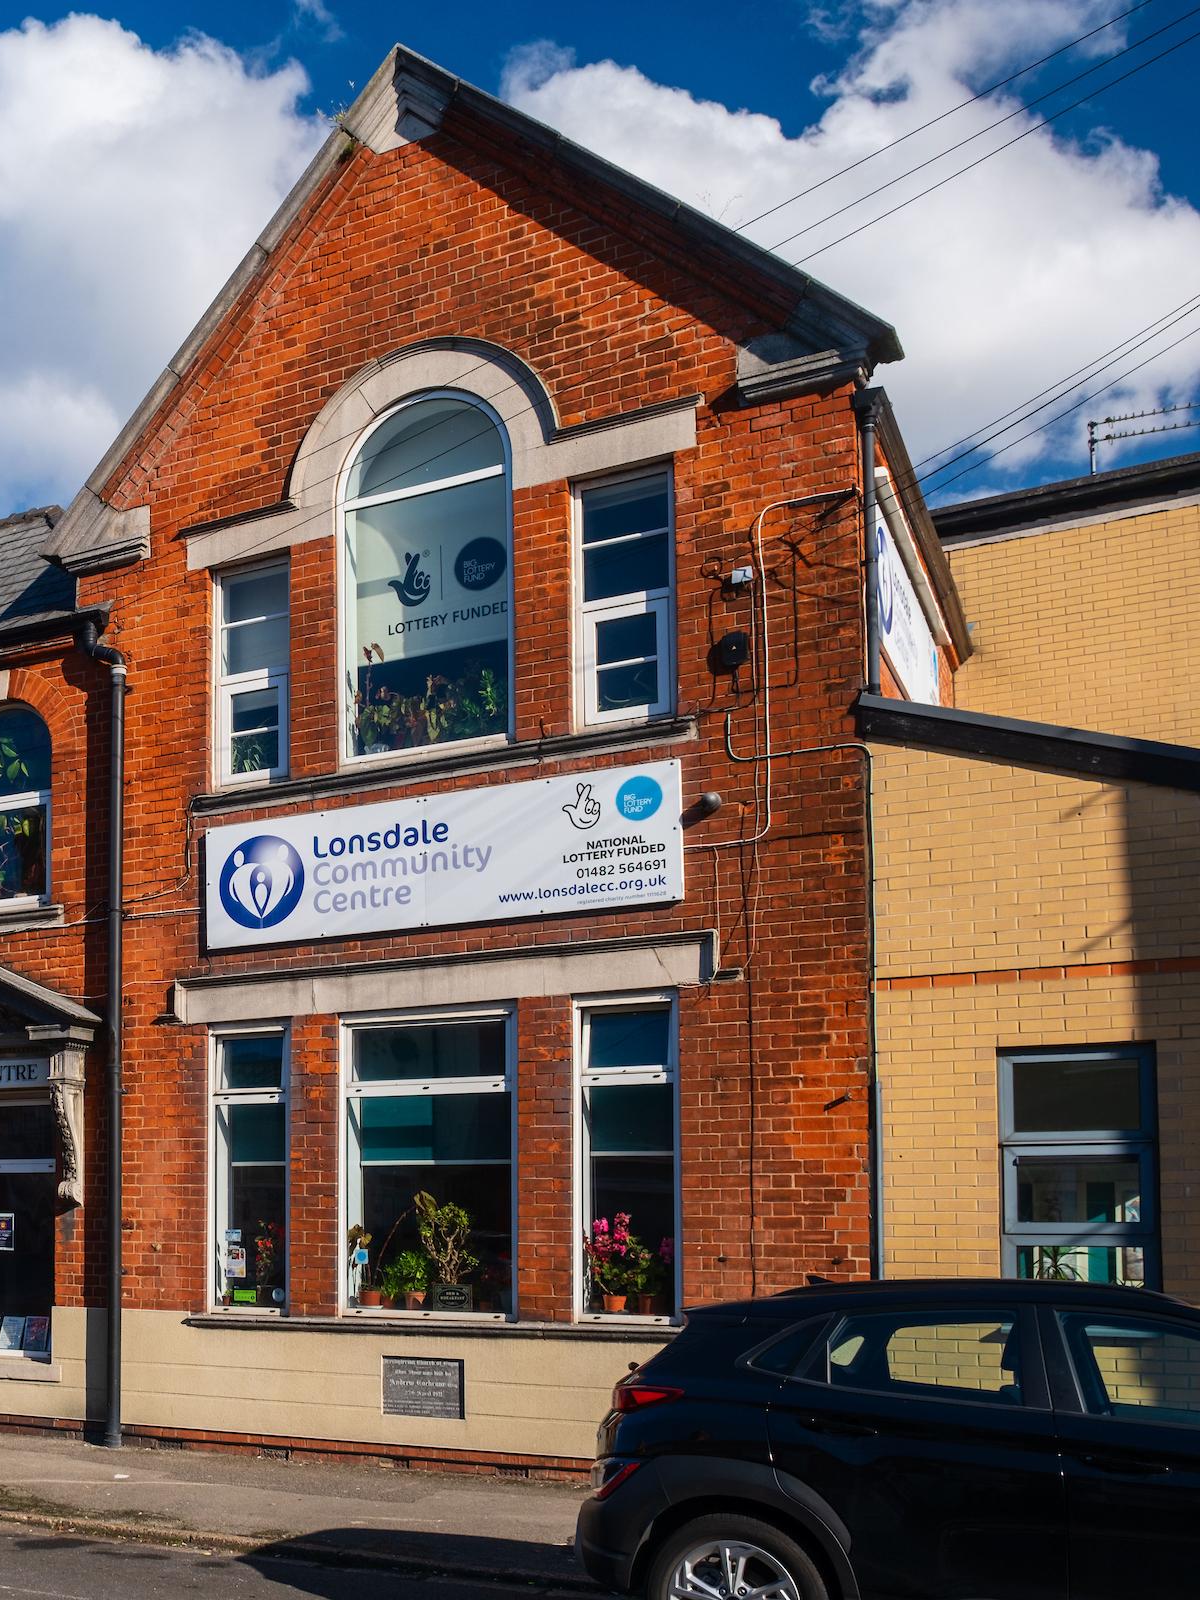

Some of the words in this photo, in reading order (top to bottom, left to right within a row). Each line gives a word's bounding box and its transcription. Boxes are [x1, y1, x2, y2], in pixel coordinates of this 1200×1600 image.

[463, 558, 477, 569] BIG
[463, 561, 496, 576] LOTTERY
[463, 572, 485, 583] FUND
[388, 612, 448, 636] LOTTERY
[453, 600, 508, 623] FUNDED
[623, 793, 636, 802] BIG
[623, 797, 653, 808] LOTTERY
[623, 805, 644, 814] FUND
[313, 819, 449, 859] Lonsdale
[586, 835, 646, 850] NATIONAL
[563, 848, 615, 864] LOTTERY
[617, 843, 666, 857] FUNDED
[313, 843, 492, 887] Community
[576, 864, 615, 879] 01482
[619, 859, 667, 874] 564691
[498, 874, 667, 903] www.lonsdalecc.org.uk
[313, 885, 412, 914] Centre
